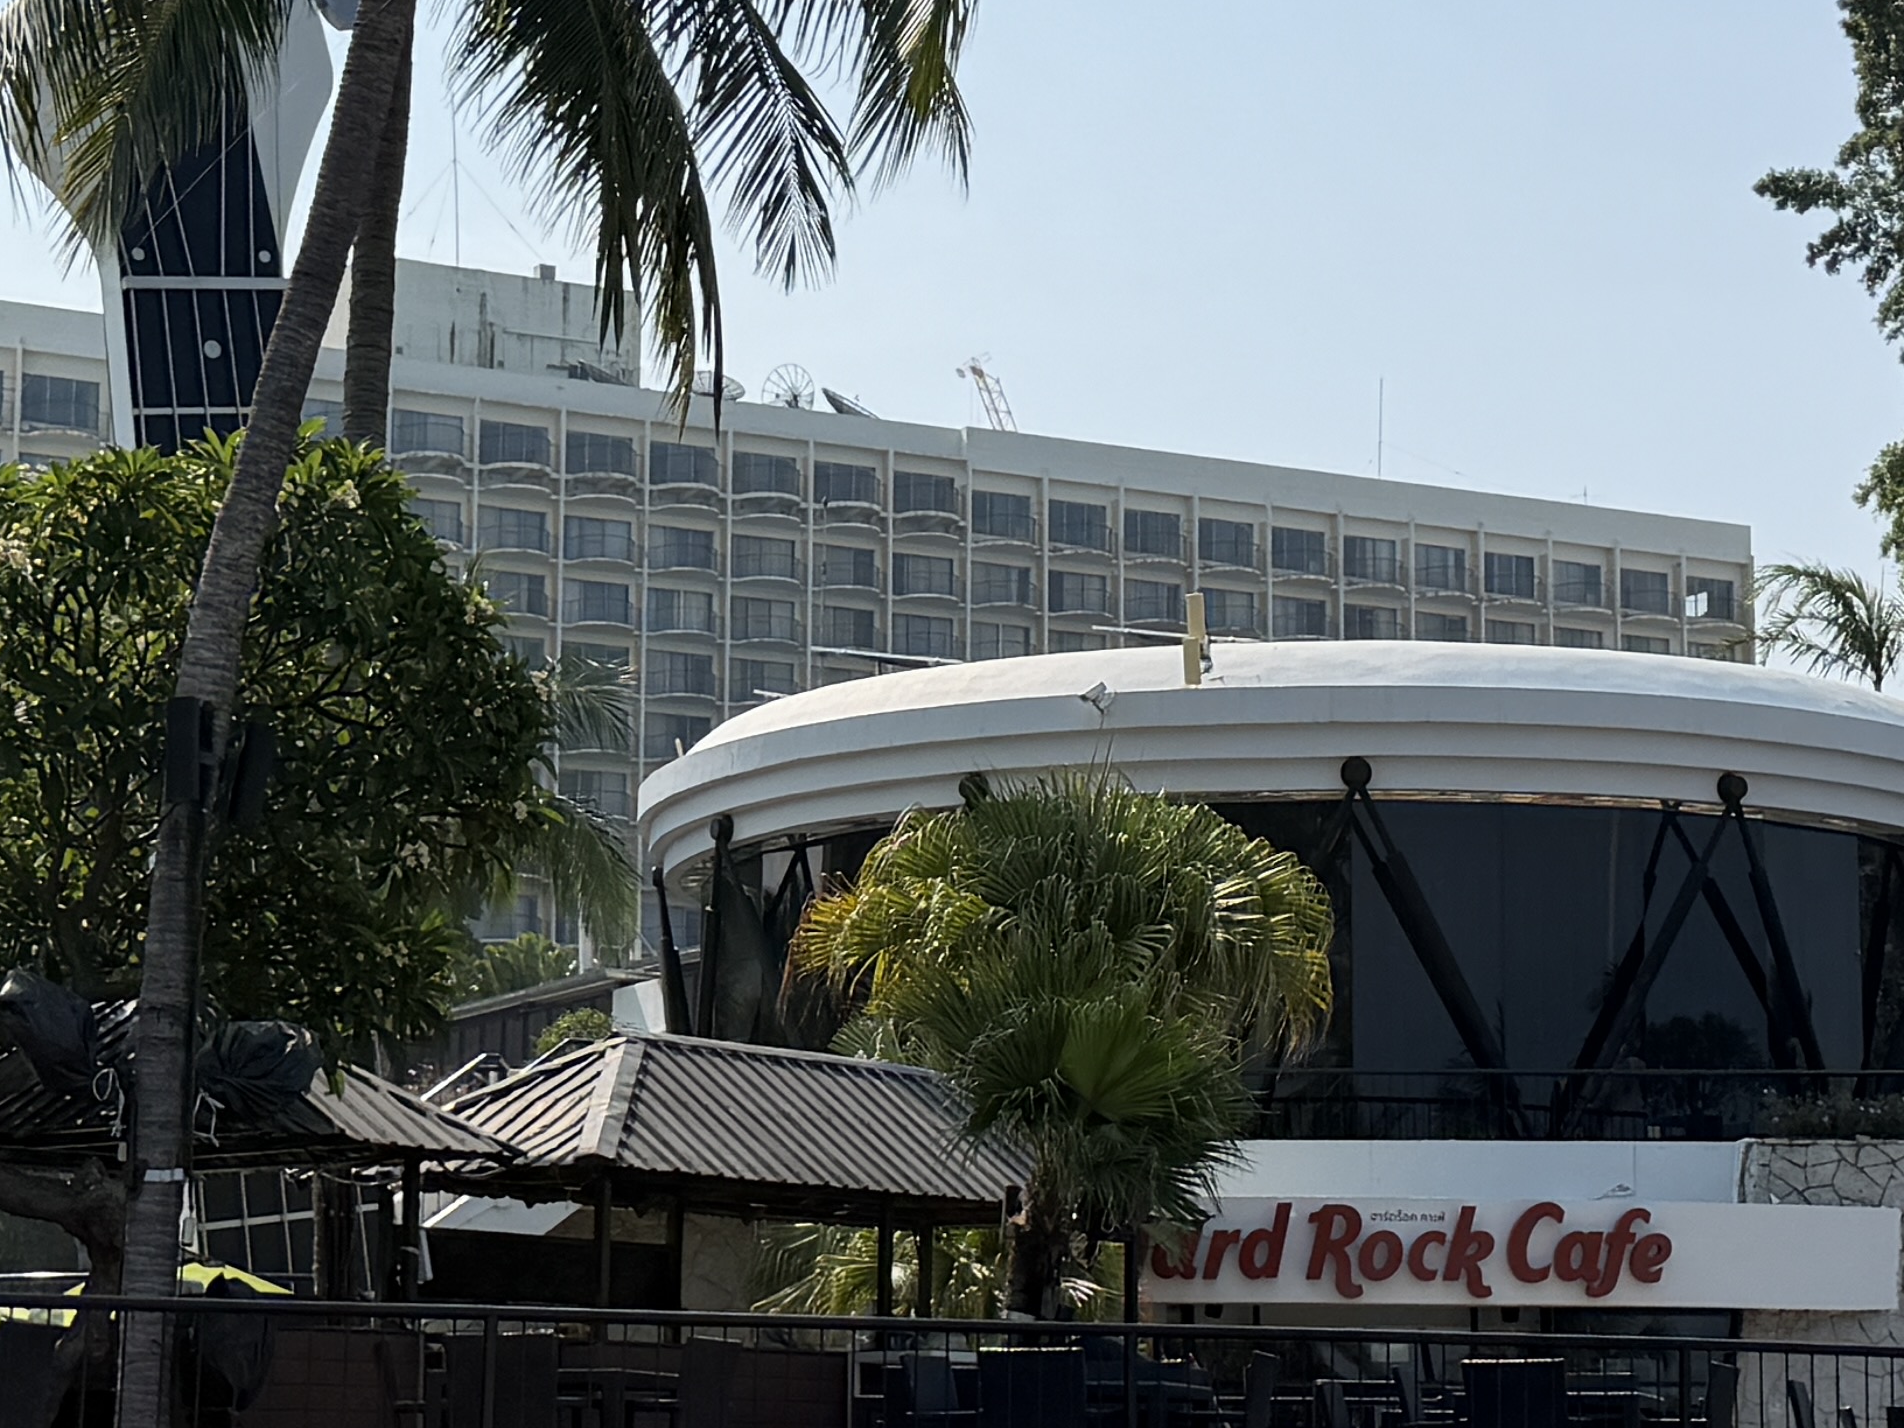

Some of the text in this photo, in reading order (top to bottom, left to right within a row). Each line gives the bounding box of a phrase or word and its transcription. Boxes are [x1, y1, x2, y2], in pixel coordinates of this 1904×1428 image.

[1151, 1201, 1673, 1299] ard Rock Cafe
